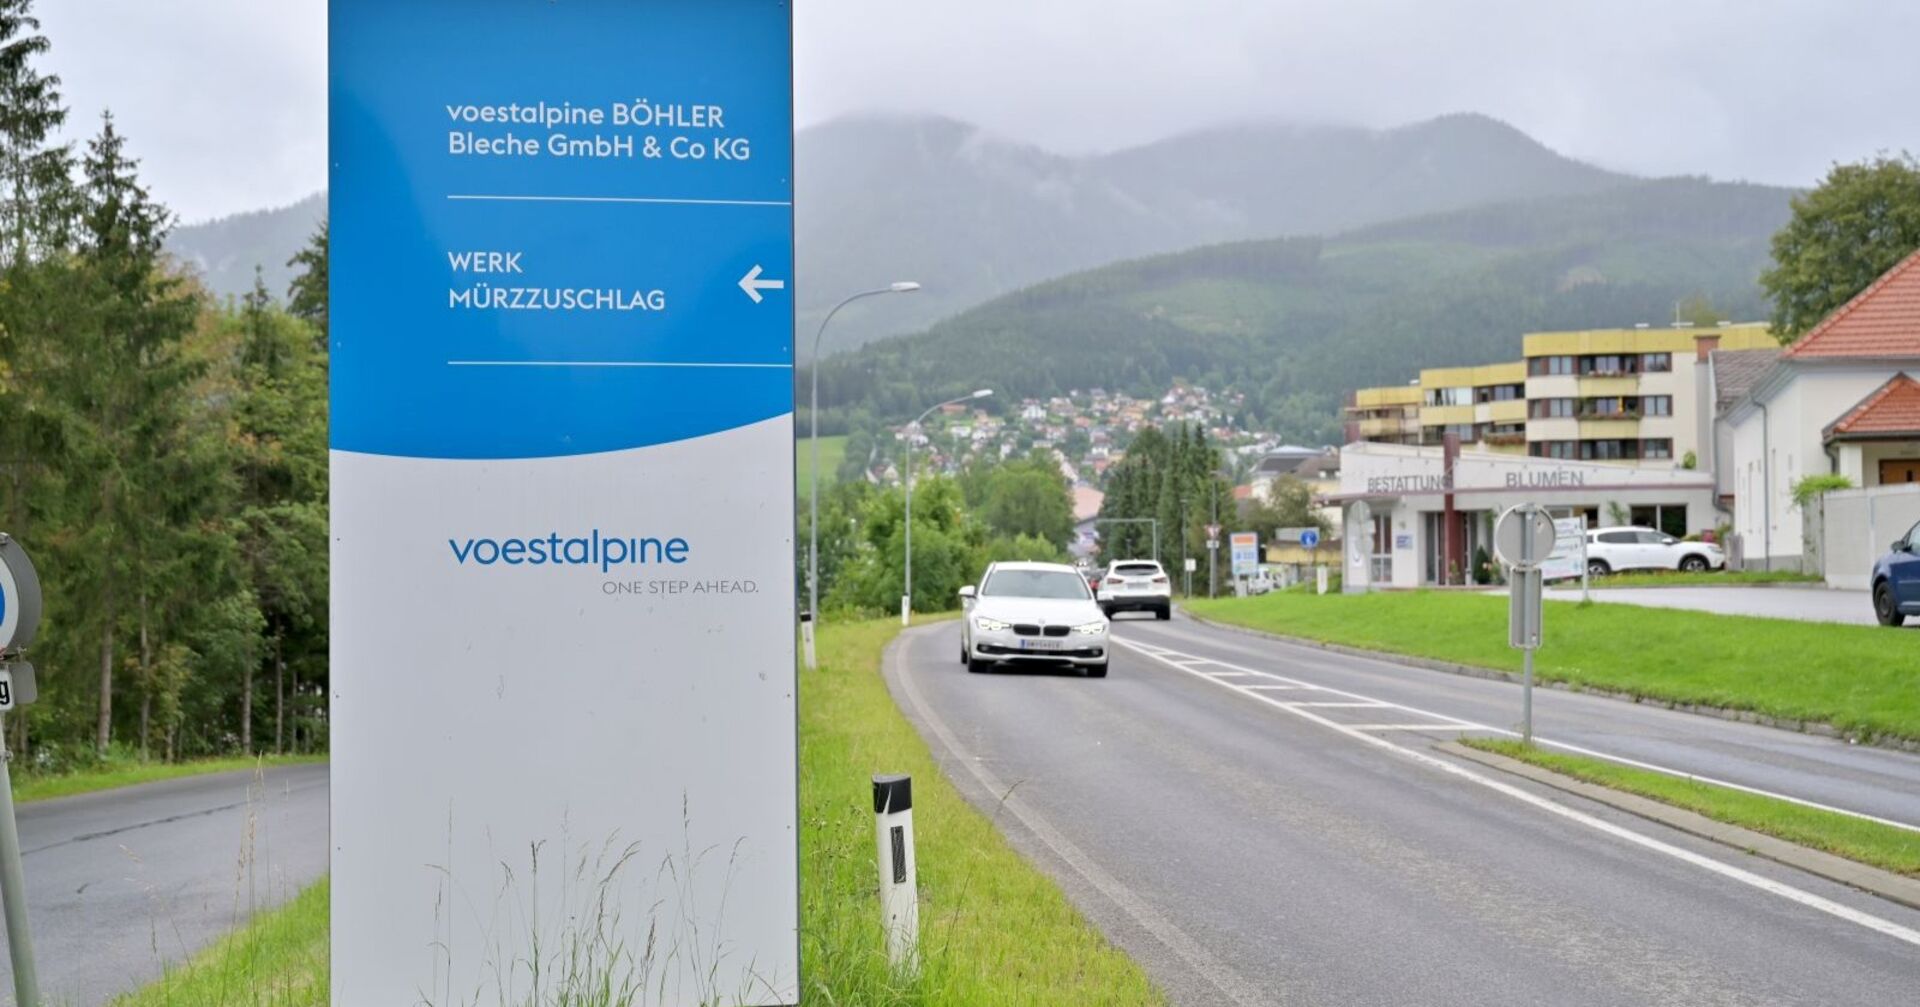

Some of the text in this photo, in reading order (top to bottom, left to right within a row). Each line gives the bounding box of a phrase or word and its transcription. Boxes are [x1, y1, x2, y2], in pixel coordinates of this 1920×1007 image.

[446, 98, 724, 129] voestalpine BÖHLER
[449, 131, 750, 161] Bleche GmbH & Co KG
[448, 251, 523, 274] WERK
[449, 282, 665, 311] MÜRZZUSCHLAG
[1505, 470, 1584, 488] BLUMEN
[448, 528, 690, 574] voestalpine
[602, 580, 759, 595] ONE STEP AHEAD.
